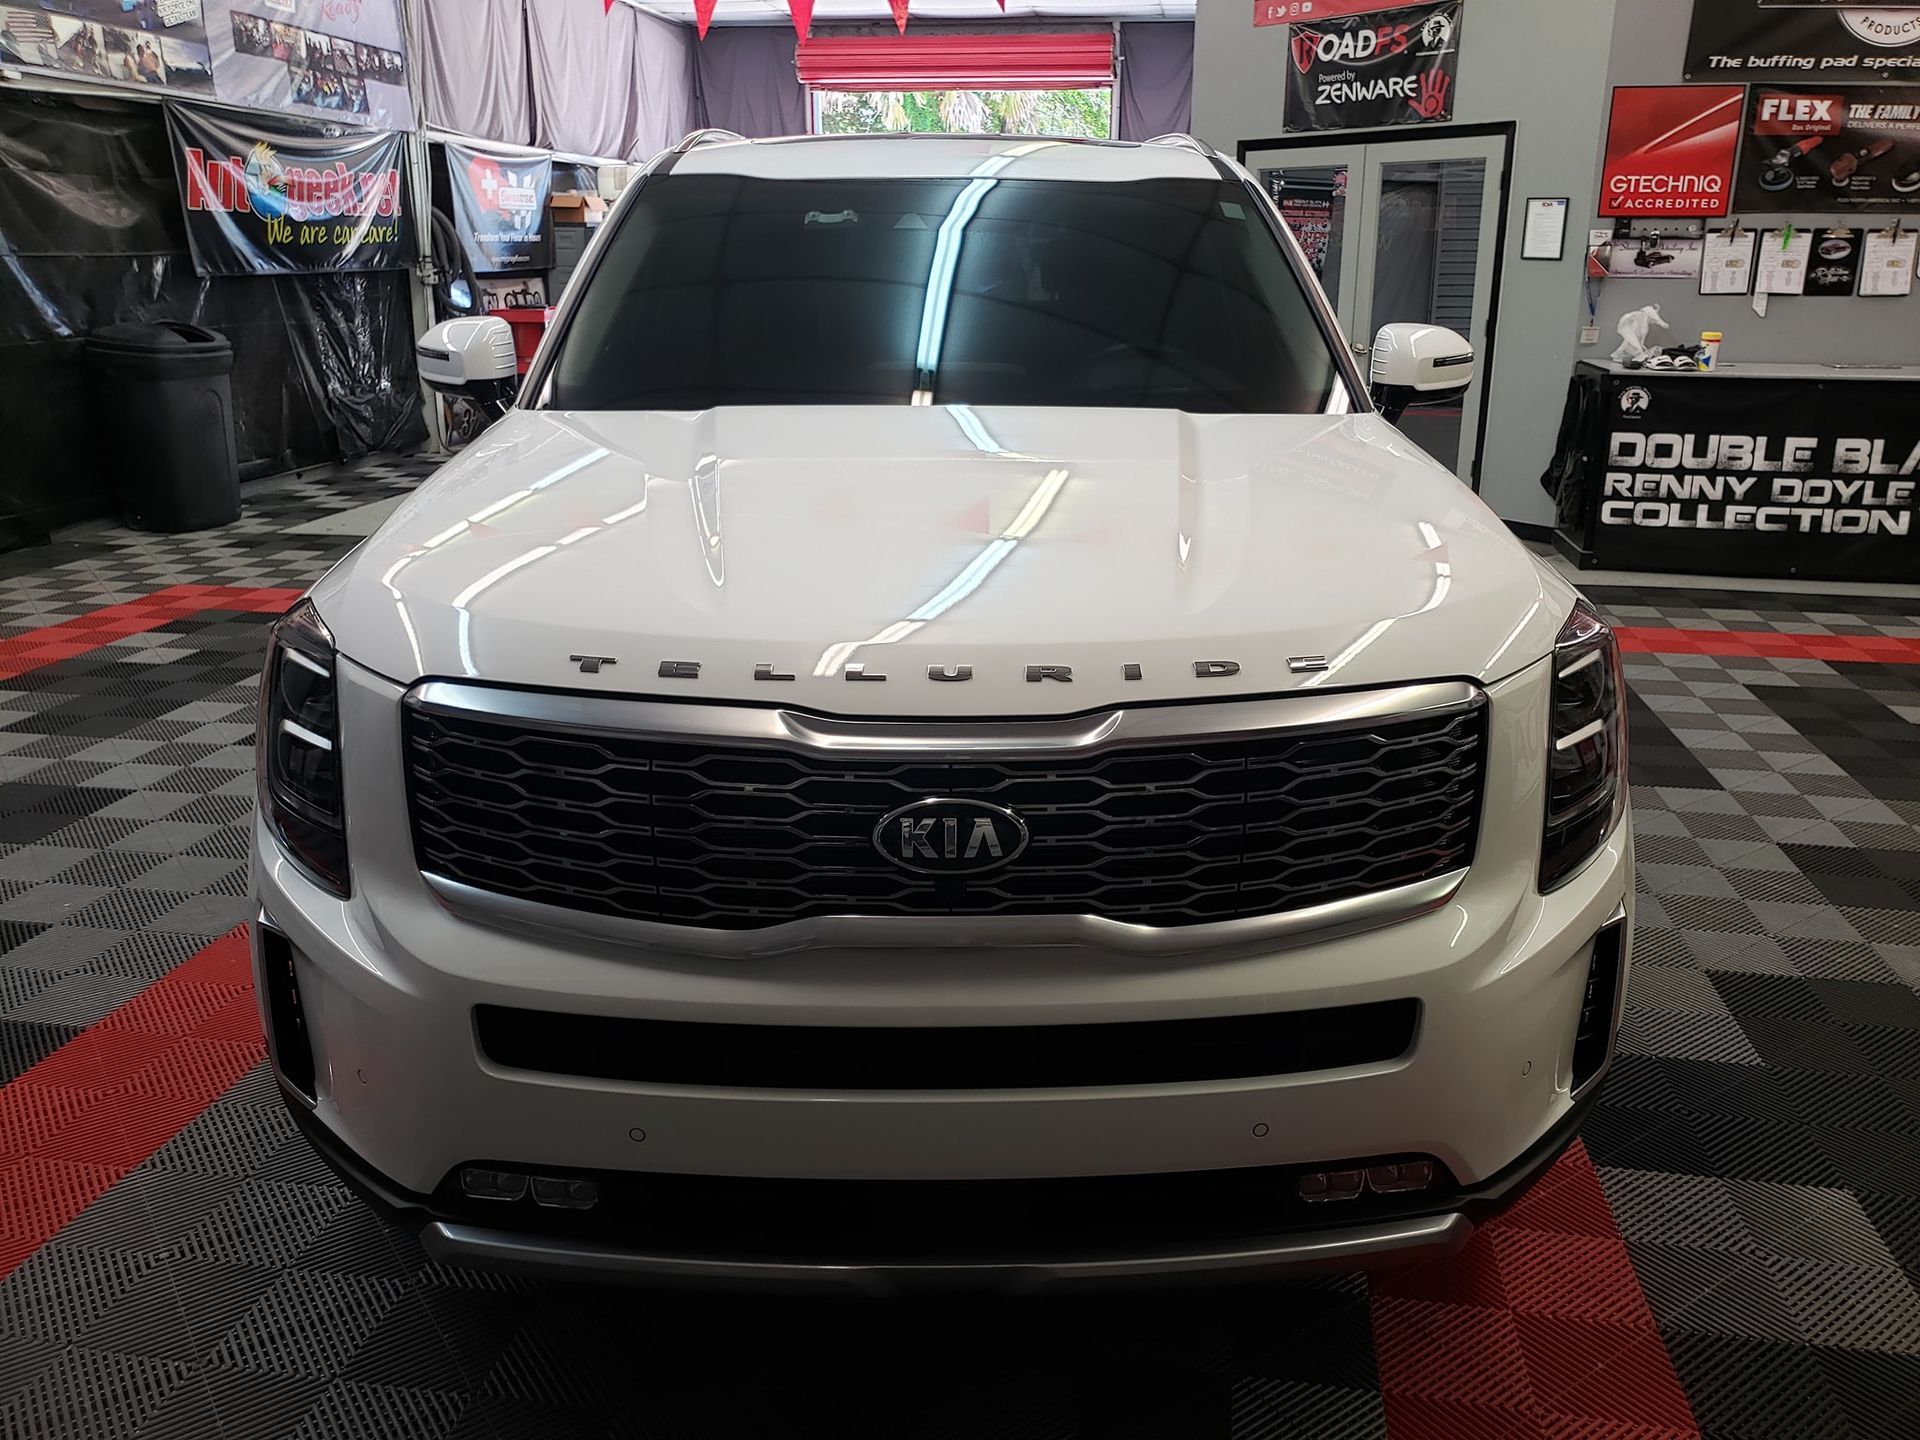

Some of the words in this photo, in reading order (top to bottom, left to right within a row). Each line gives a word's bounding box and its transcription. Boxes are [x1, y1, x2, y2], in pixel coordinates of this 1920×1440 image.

[1708, 56, 1742, 68] The
[1747, 55, 1815, 70] buffing
[1819, 55, 1858, 69] pad
[1314, 75, 1418, 105] ZENWARE
[1318, 73, 1346, 84] Powered
[1346, 70, 1356, 82] by
[1761, 99, 1833, 121] FLEX
[1849, 104, 1874, 119] THE
[1609, 174, 1722, 193] GTECHNIQ
[1624, 198, 1720, 209] ACCREDITED
[267, 213, 294, 246] We
[299, 224, 328, 246] are
[1608, 431, 1818, 473] DOUBLE
[1603, 472, 1758, 501] RENNY
[1770, 477, 1916, 506] DOYLE
[1601, 500, 1911, 536] COLLECTION
[569, 654, 1329, 682] TELLURIDE
[900, 817, 1004, 859] KIA
